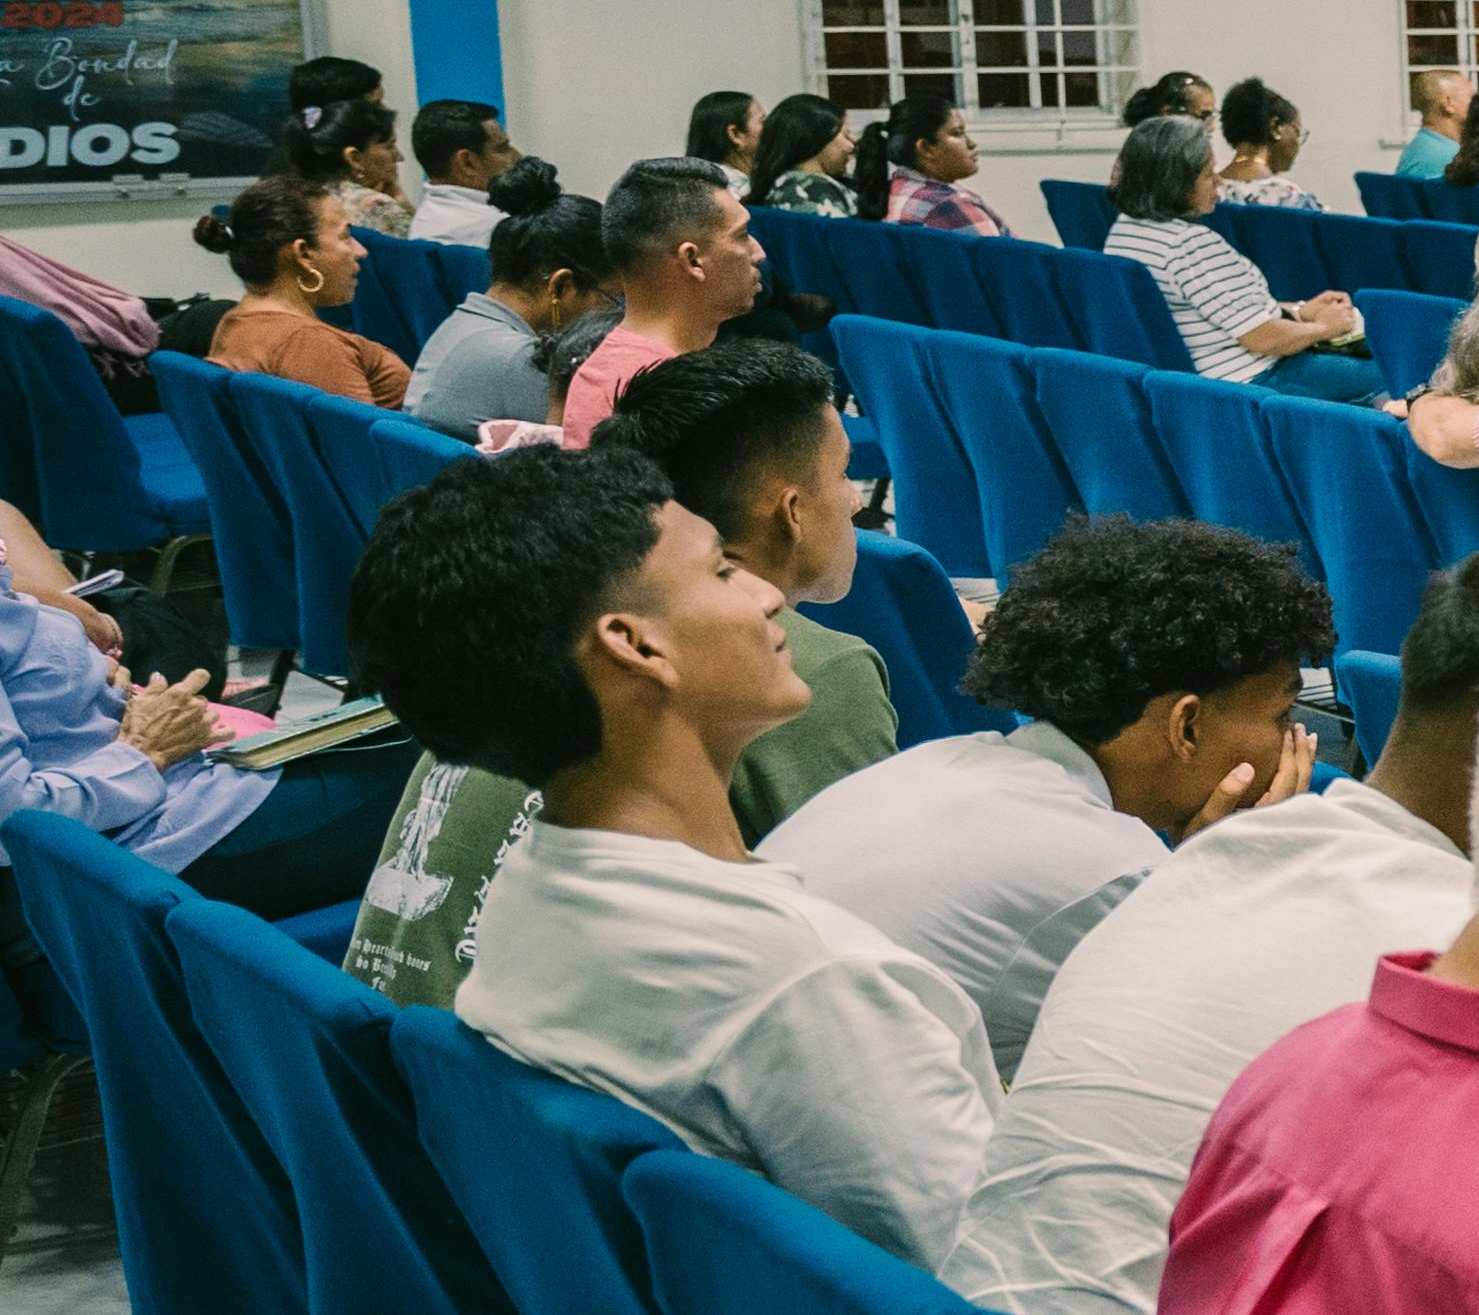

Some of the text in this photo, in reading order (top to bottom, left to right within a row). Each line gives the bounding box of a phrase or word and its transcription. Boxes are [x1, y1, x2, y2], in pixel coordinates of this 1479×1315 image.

[35, 36, 179, 91] Bondad
[62, 74, 102, 122] de
[0, 120, 181, 169] DIOS
